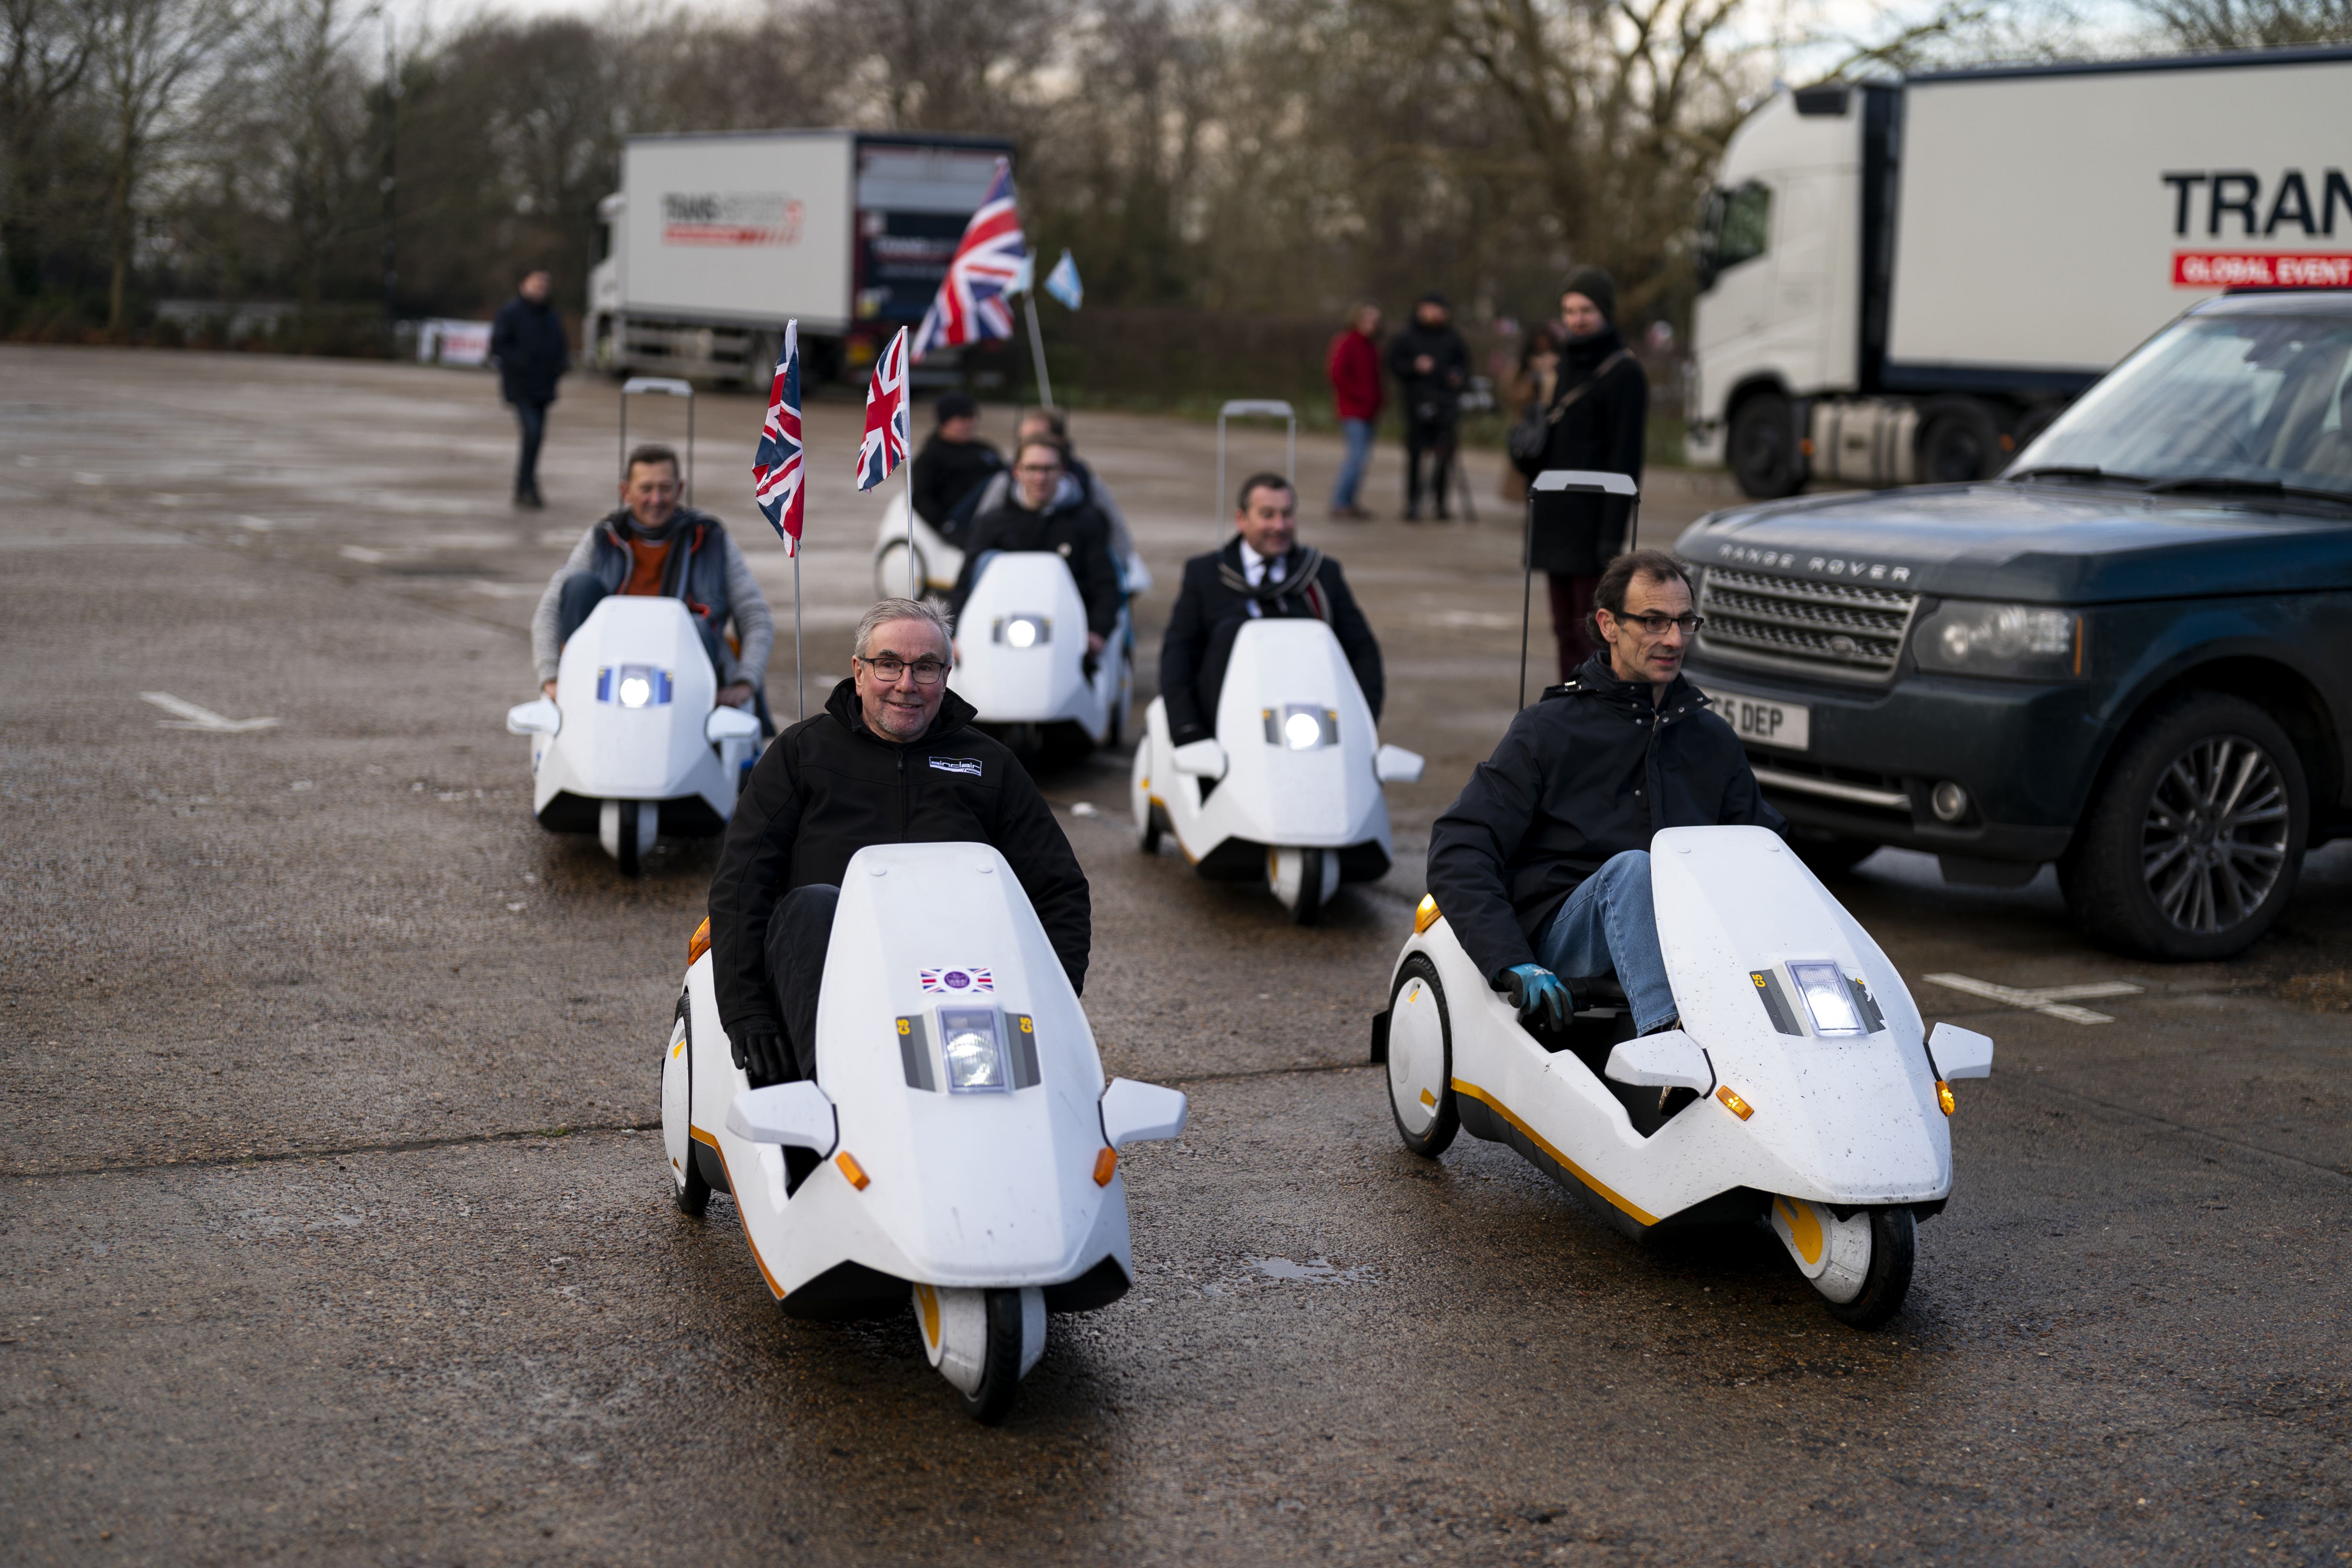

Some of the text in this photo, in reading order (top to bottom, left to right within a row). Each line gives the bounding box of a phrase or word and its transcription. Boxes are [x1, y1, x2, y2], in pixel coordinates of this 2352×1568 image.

[2182, 256, 2275, 284] GLOBAL
[1717, 543, 1910, 582] RANGE ROVER
[1742, 702, 1783, 737] DEP
[1752, 974, 1766, 987] C5
[897, 1019, 910, 1035] C5
[1020, 1017, 1032, 1034] C5
